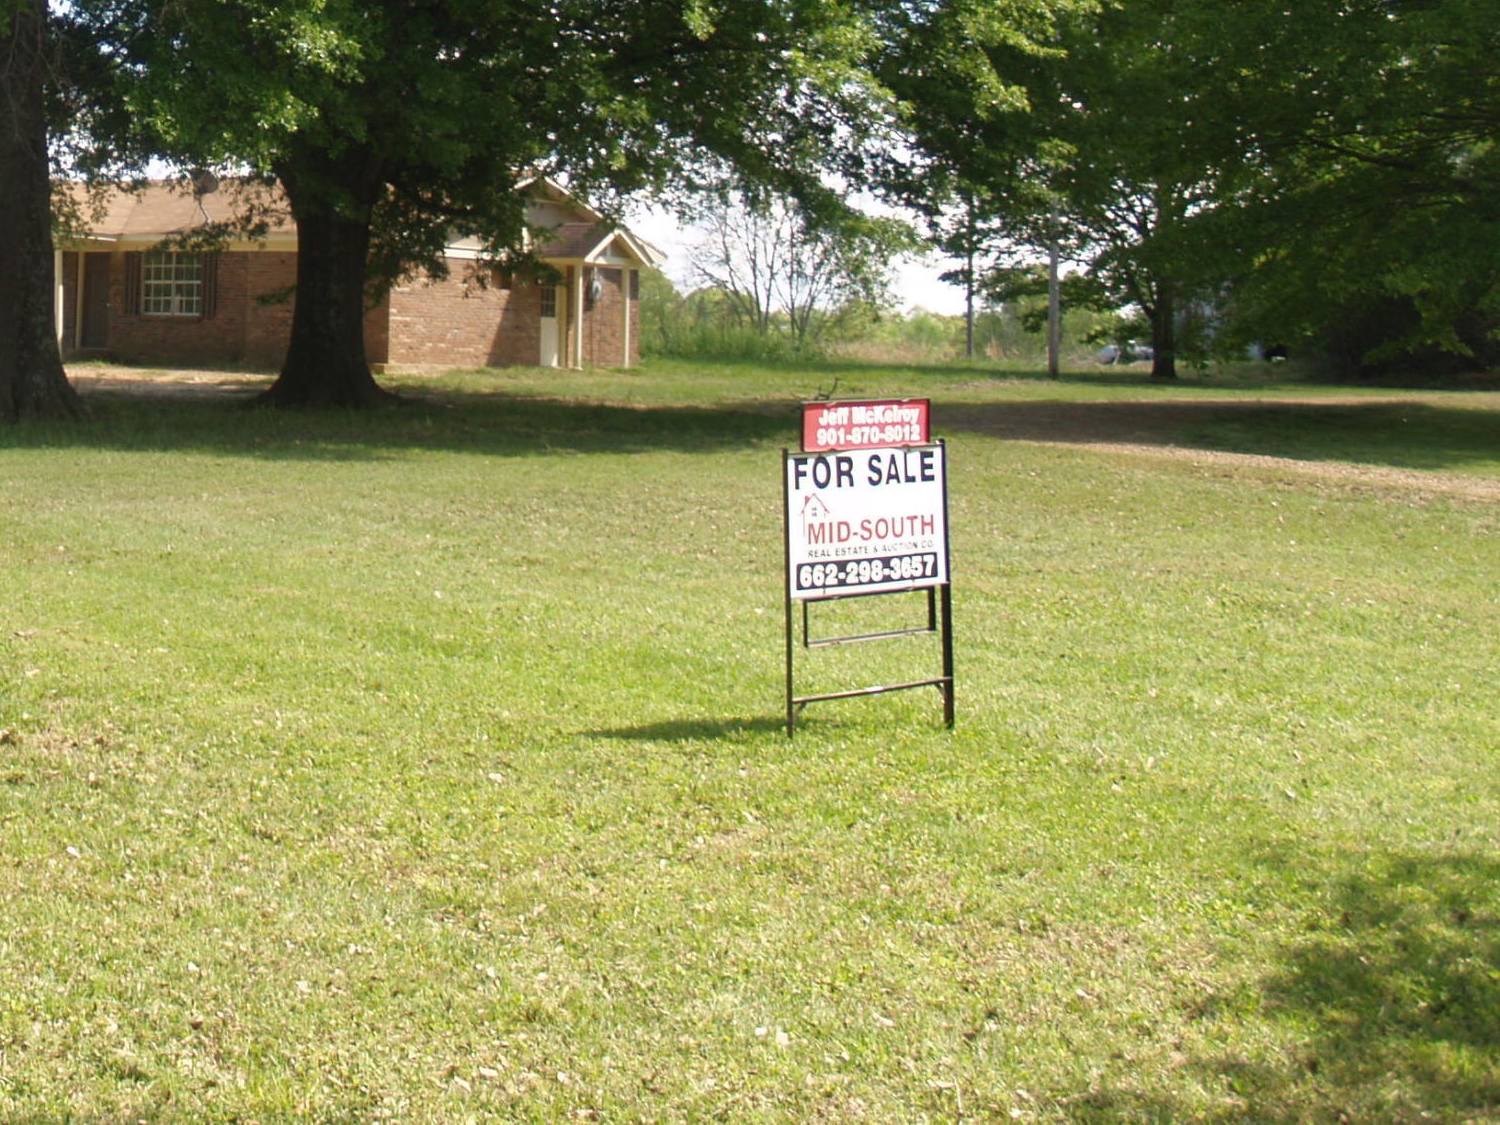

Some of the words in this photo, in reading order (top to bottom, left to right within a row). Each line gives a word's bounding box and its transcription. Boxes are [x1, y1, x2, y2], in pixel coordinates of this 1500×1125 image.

[818, 407, 849, 426] Jeff
[851, 405, 920, 425] McKelroy
[817, 424, 921, 446] 901-870-8012
[794, 455, 854, 490] FOR
[867, 451, 935, 487] SALE
[808, 514, 935, 545] MID-SOUTH
[807, 549, 831, 558] REAL
[835, 546, 868, 557] ESTATE
[882, 541, 918, 552] AUCON
[799, 554, 935, 588] 662-298-3657
